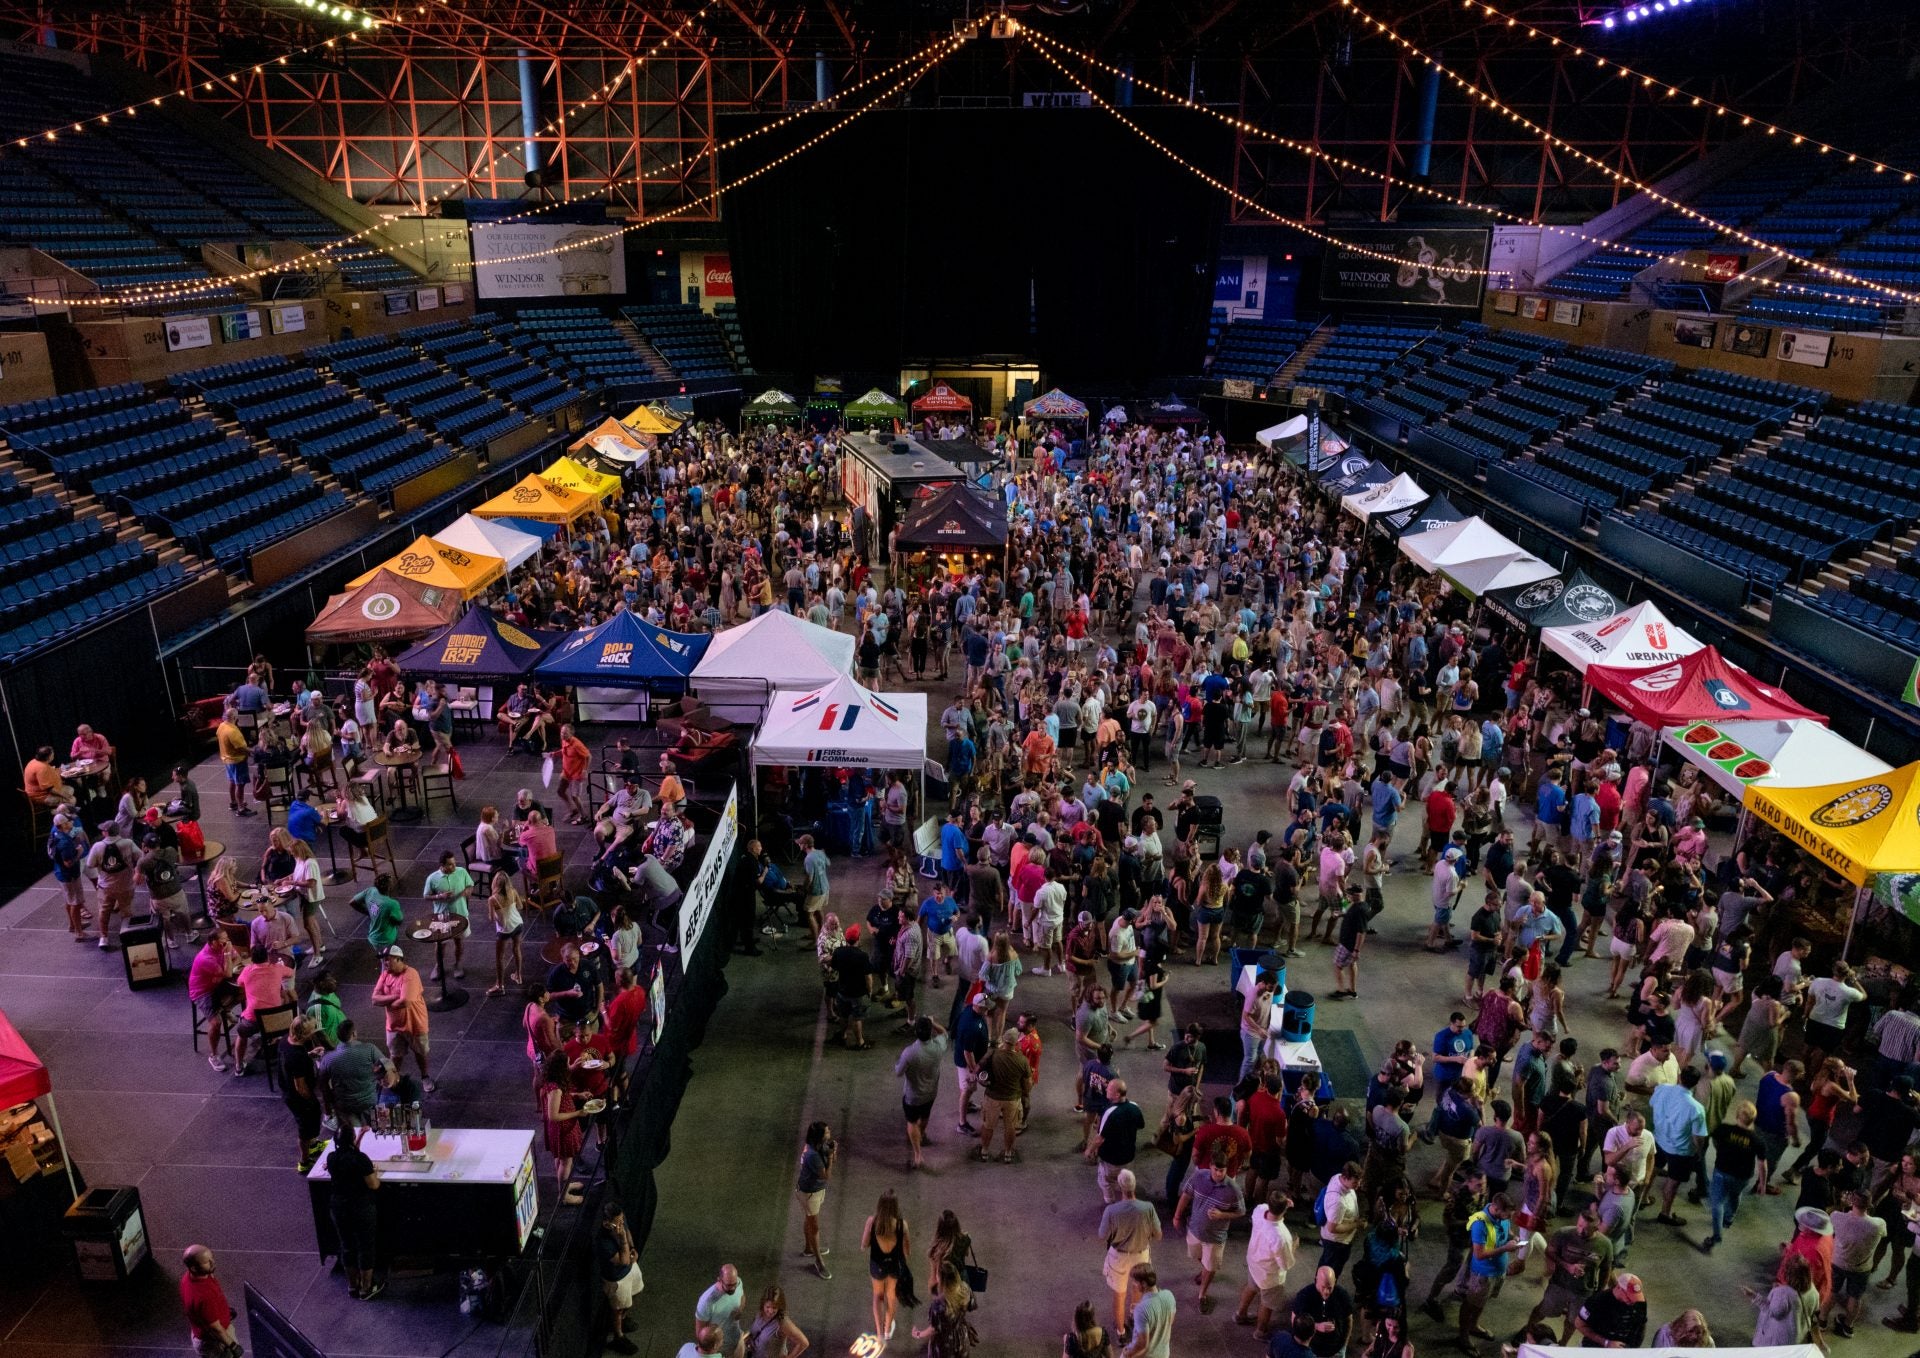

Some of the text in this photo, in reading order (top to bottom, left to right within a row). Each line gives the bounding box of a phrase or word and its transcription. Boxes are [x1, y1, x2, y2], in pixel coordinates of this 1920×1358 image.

[446, 232, 462, 240] Exit
[1498, 238, 1515, 246] Exit
[494, 274, 545, 283] WINDSOR
[1216, 275, 1240, 287] ANI
[1339, 272, 1391, 283] WINDSOR
[326, 299, 342, 313] 122
[143, 333, 157, 345] 124
[7, 351, 23, 365] 101
[1840, 346, 1854, 361] 113
[400, 554, 434, 570] Beer
[1567, 586, 1608, 599] WILD LEAP
[1495, 604, 1507, 618] LEAP
[447, 634, 488, 649] COLUMBIA
[1571, 629, 1607, 654] URBANTREE
[441, 647, 482, 664] CRAFT
[602, 643, 634, 657] BOLD
[1626, 652, 1689, 661] URBANTR
[600, 652, 632, 664] ROCK
[1754, 796, 1781, 823] HARD
[1784, 816, 1817, 849] DUTCH
[684, 898, 704, 949] BEER
[704, 849, 722, 899] FANS
[521, 1180, 534, 1226] VIP
